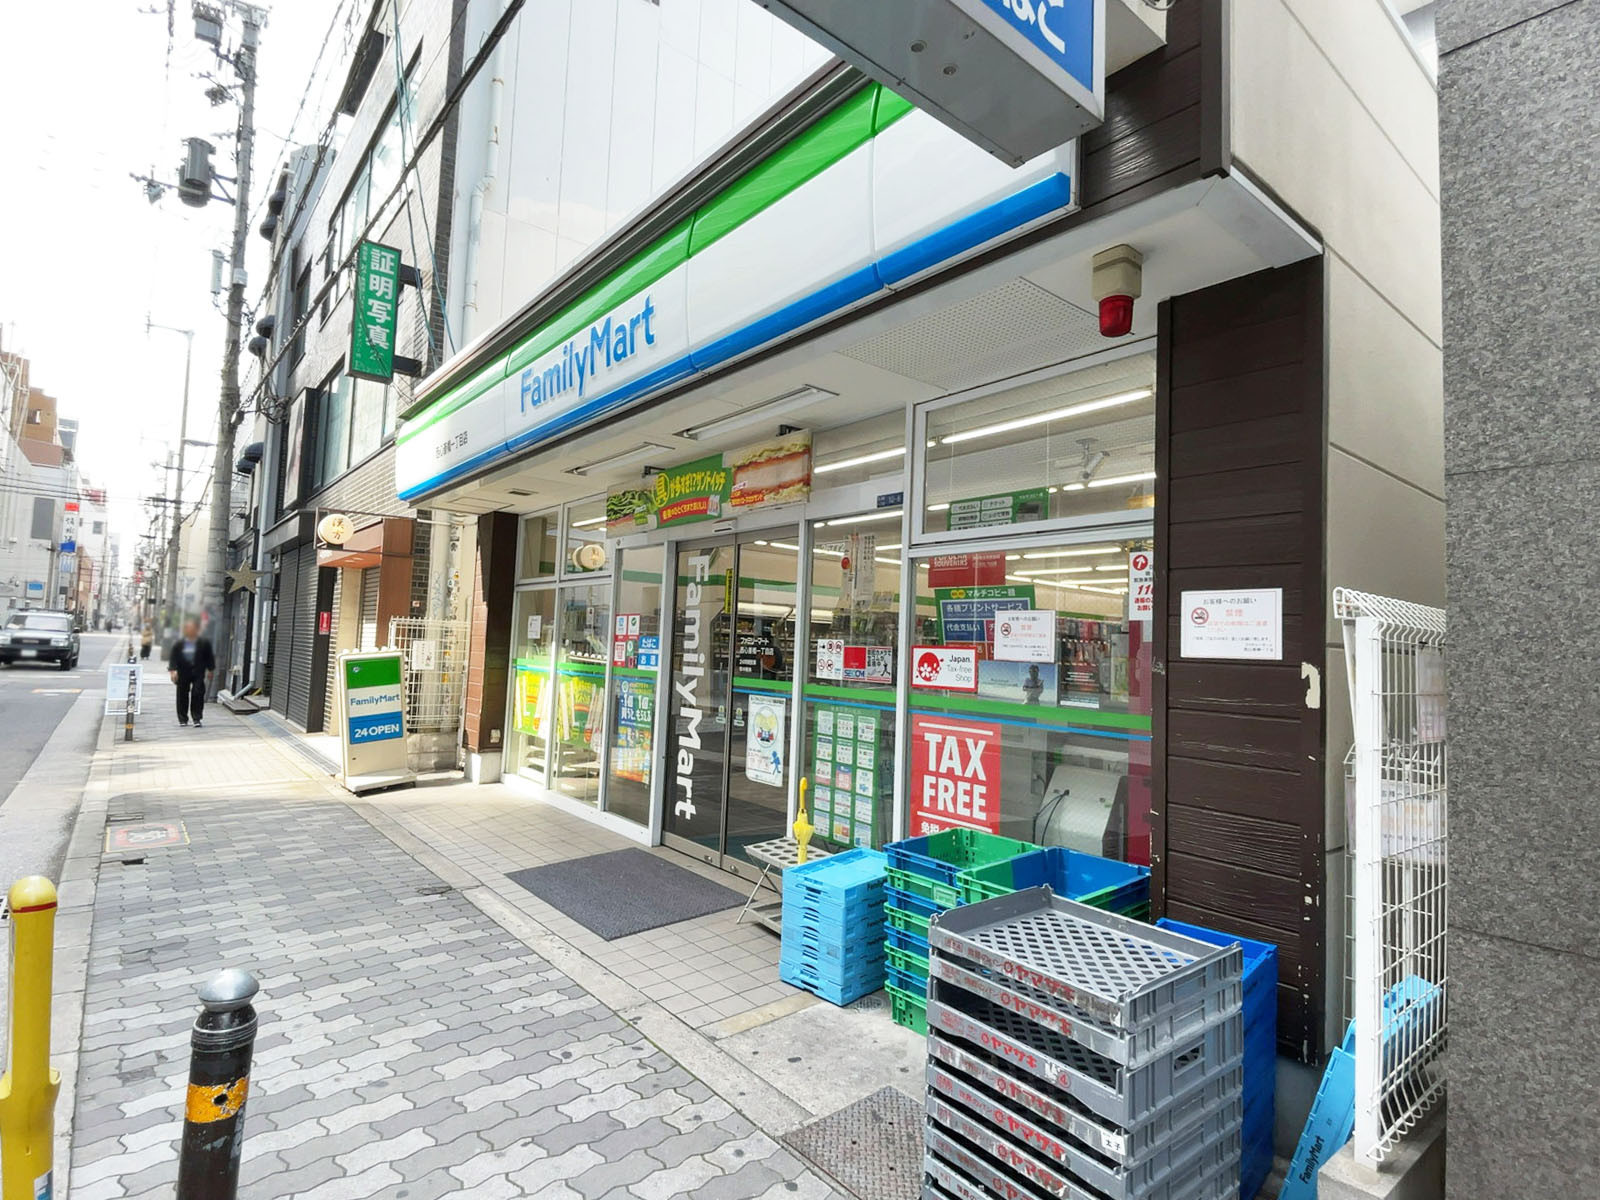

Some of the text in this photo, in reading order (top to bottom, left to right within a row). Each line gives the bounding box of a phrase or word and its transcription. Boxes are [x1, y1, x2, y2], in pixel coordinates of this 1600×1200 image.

[367, 247, 396, 350] 証明写真
[520, 294, 655, 413] FamilyMart
[641, 637, 657, 648] たばこ
[674, 554, 710, 820] FamilyMart
[844, 669, 865, 678] SECOM
[350, 693, 401, 706] FamilyMart
[924, 732, 987, 781] TAX
[922, 774, 987, 821] FREE
[1016, 964, 1076, 1001] ヤマザキ
[1012, 995, 1073, 1036] ヤマザキ
[990, 1035, 1037, 1069] ヤマザキ
[1007, 1114, 1065, 1159] ヤマザキ
[1299, 1135, 1325, 1184] FamilyMart
